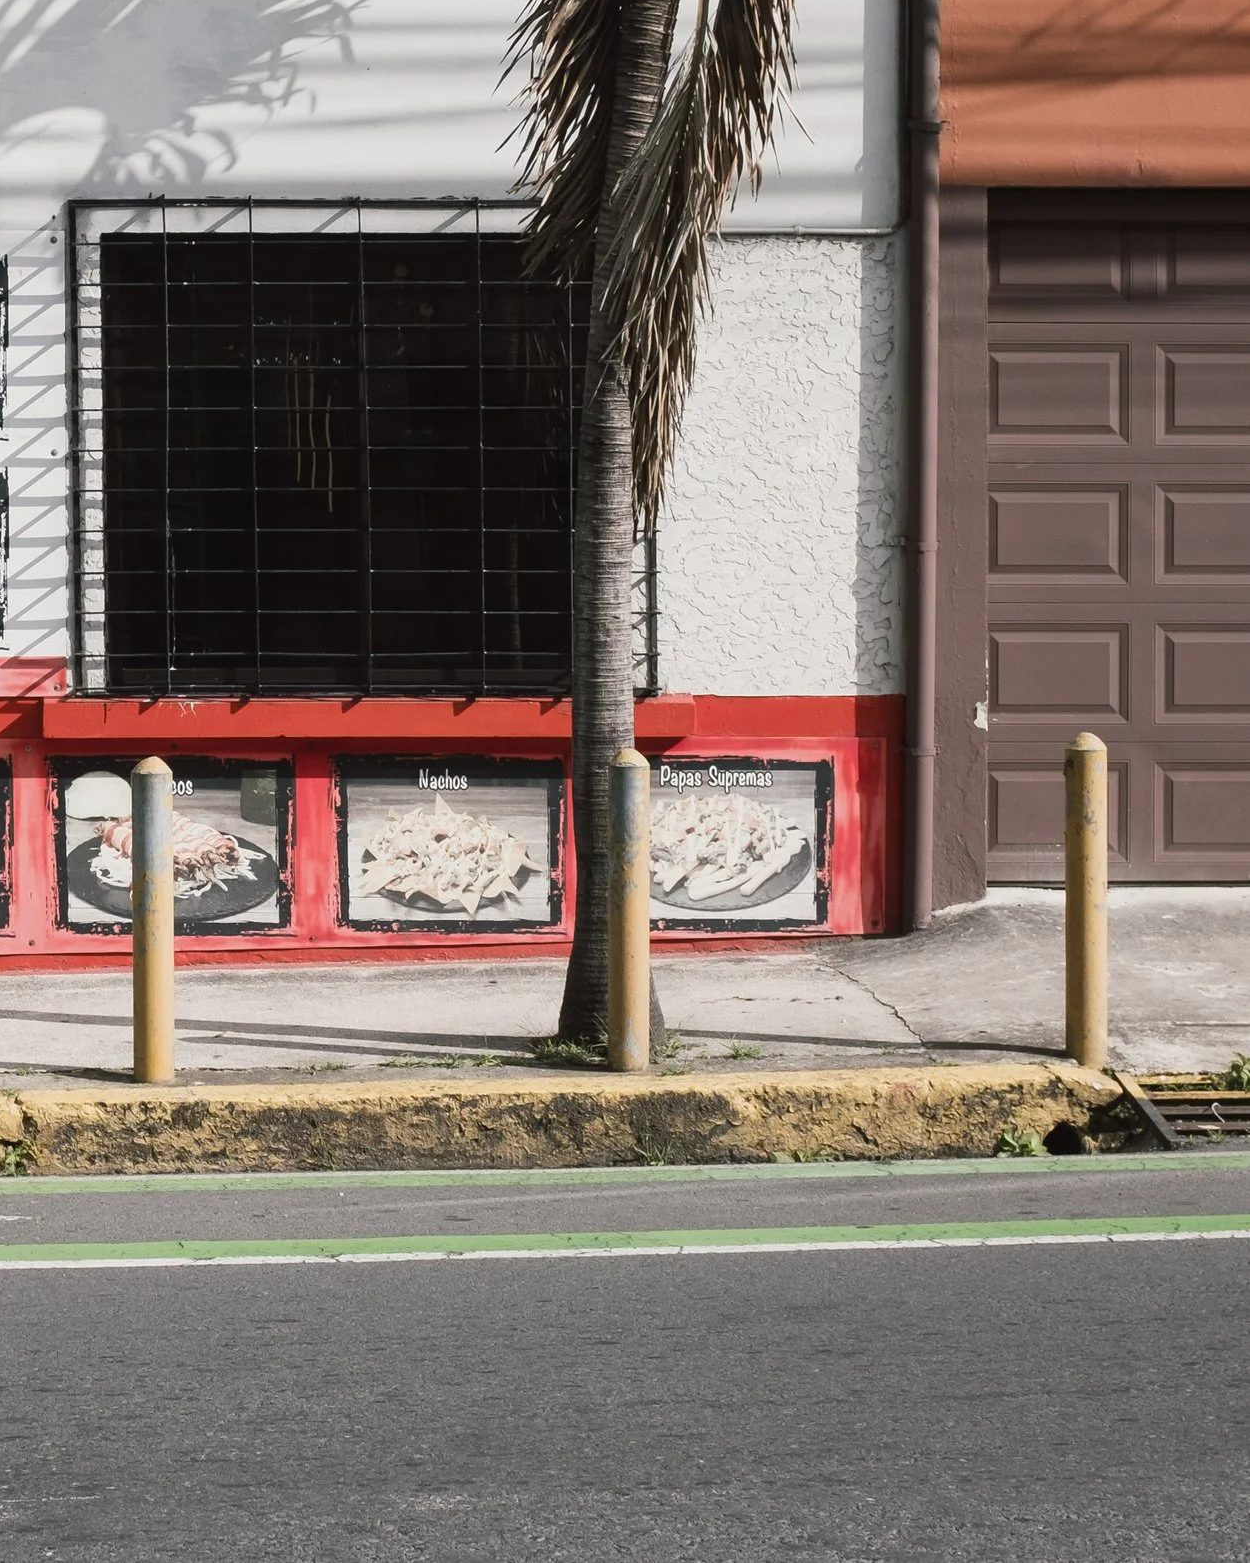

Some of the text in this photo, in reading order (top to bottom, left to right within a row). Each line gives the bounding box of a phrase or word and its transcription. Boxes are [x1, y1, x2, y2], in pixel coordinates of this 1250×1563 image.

[418, 767, 470, 791] Nachos
[659, 764, 774, 795] Papas Supremas
